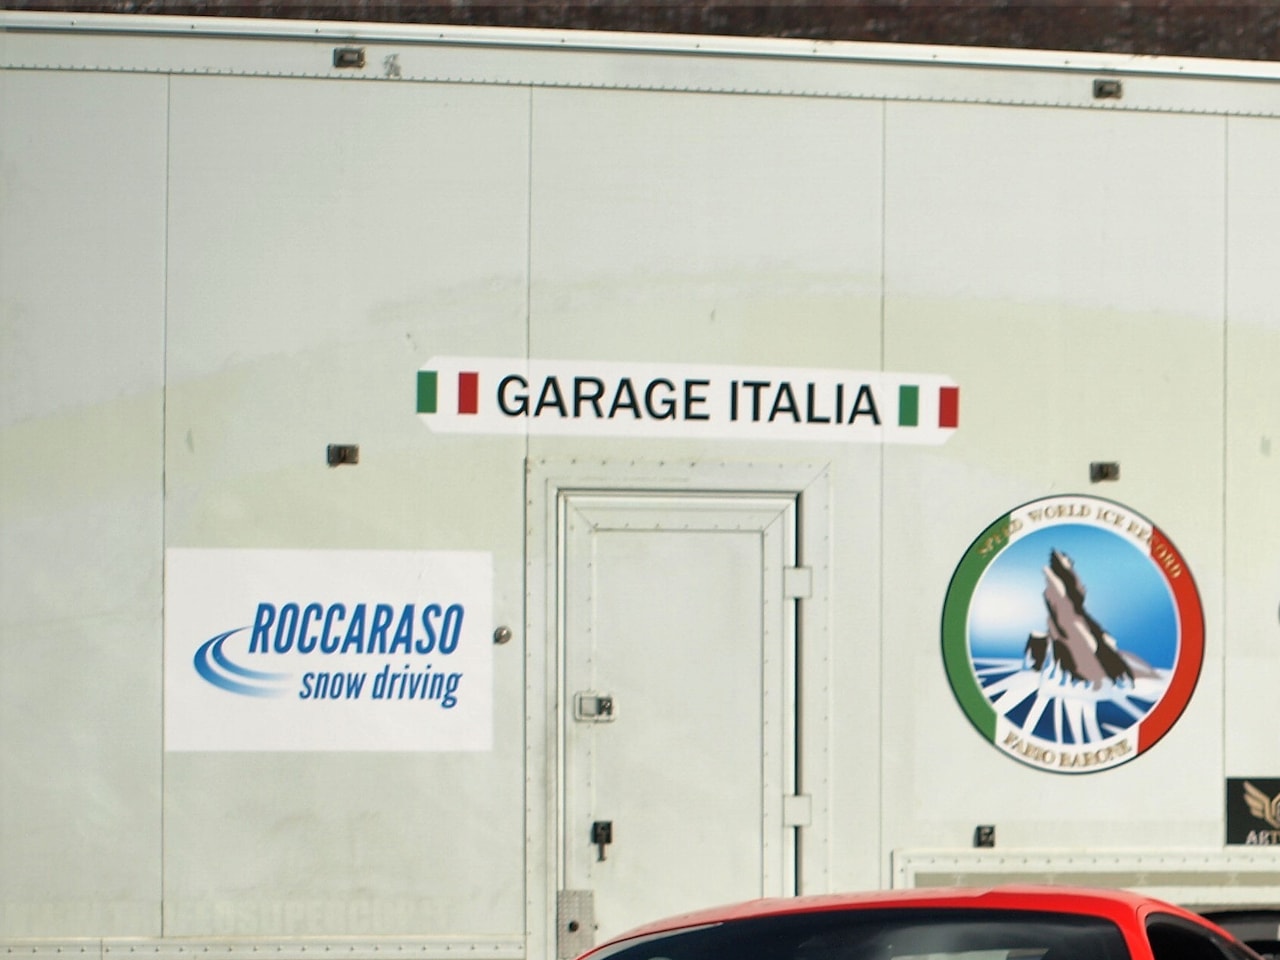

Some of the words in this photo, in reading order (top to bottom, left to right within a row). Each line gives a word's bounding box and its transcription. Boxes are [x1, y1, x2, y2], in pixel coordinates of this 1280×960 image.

[496, 374, 711, 421] GARAGE
[729, 379, 882, 426] ITALIA
[1027, 503, 1091, 523] WORLD
[1096, 505, 1125, 527] ICE
[248, 602, 465, 655] ROCCARASO
[298, 671, 368, 700] snow
[371, 664, 463, 709] driving
[1003, 730, 1057, 766] FABIO
[1058, 738, 1133, 768] BARONE
